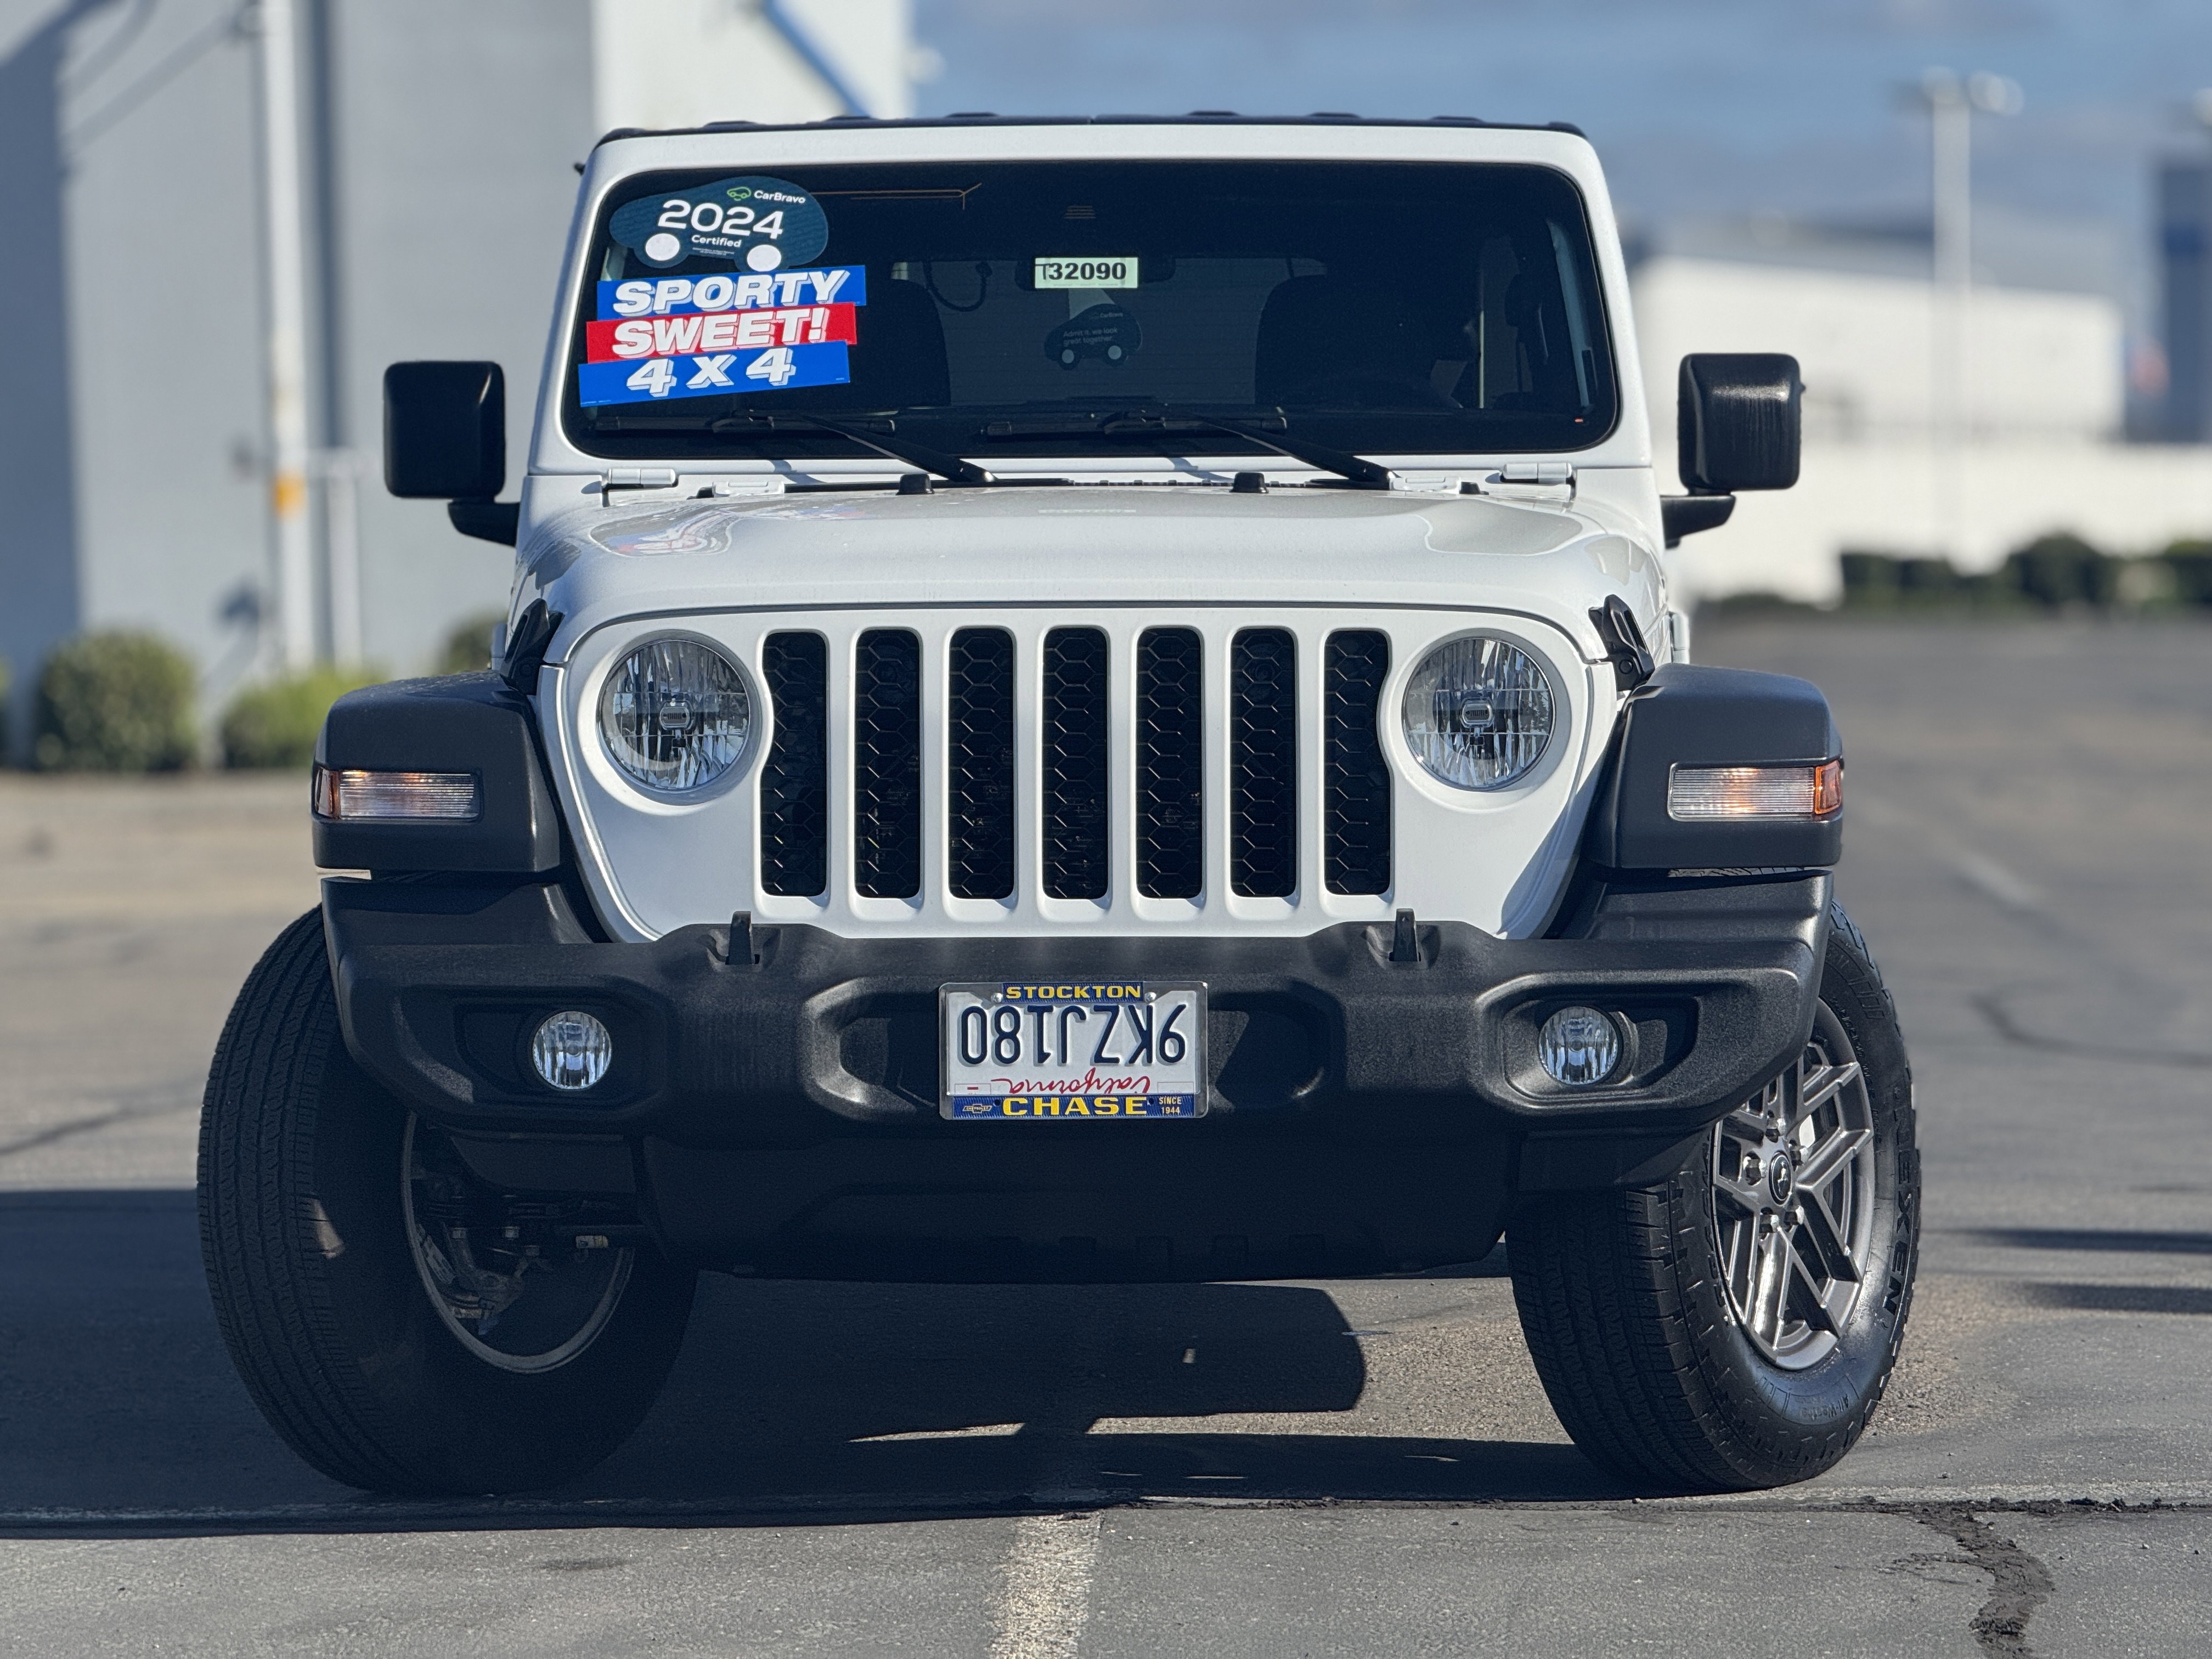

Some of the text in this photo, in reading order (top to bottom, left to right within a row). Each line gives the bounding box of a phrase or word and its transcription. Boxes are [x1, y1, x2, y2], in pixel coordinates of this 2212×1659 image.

[753, 189, 806, 205] CarBravo
[658, 199, 785, 240] 2024
[691, 234, 742, 249] Certified
[613, 269, 851, 317] SPORTY
[612, 307, 830, 359] SWEET!
[1063, 329, 1084, 337] Admit
[1063, 337, 1081, 347] great
[626, 358, 677, 398] 4
[746, 347, 797, 386] 4
[1006, 985, 1141, 1000] STOCKTON
[961, 1004, 1187, 1064] 9KZJ180
[990, 1066, 1150, 1094] California
[1002, 1096, 1147, 1116] CHASE
[1159, 1096, 1182, 1105] SINCE
[1161, 1106, 1181, 1115] 1944
[1882, 1108, 1915, 1316] NEXEN
